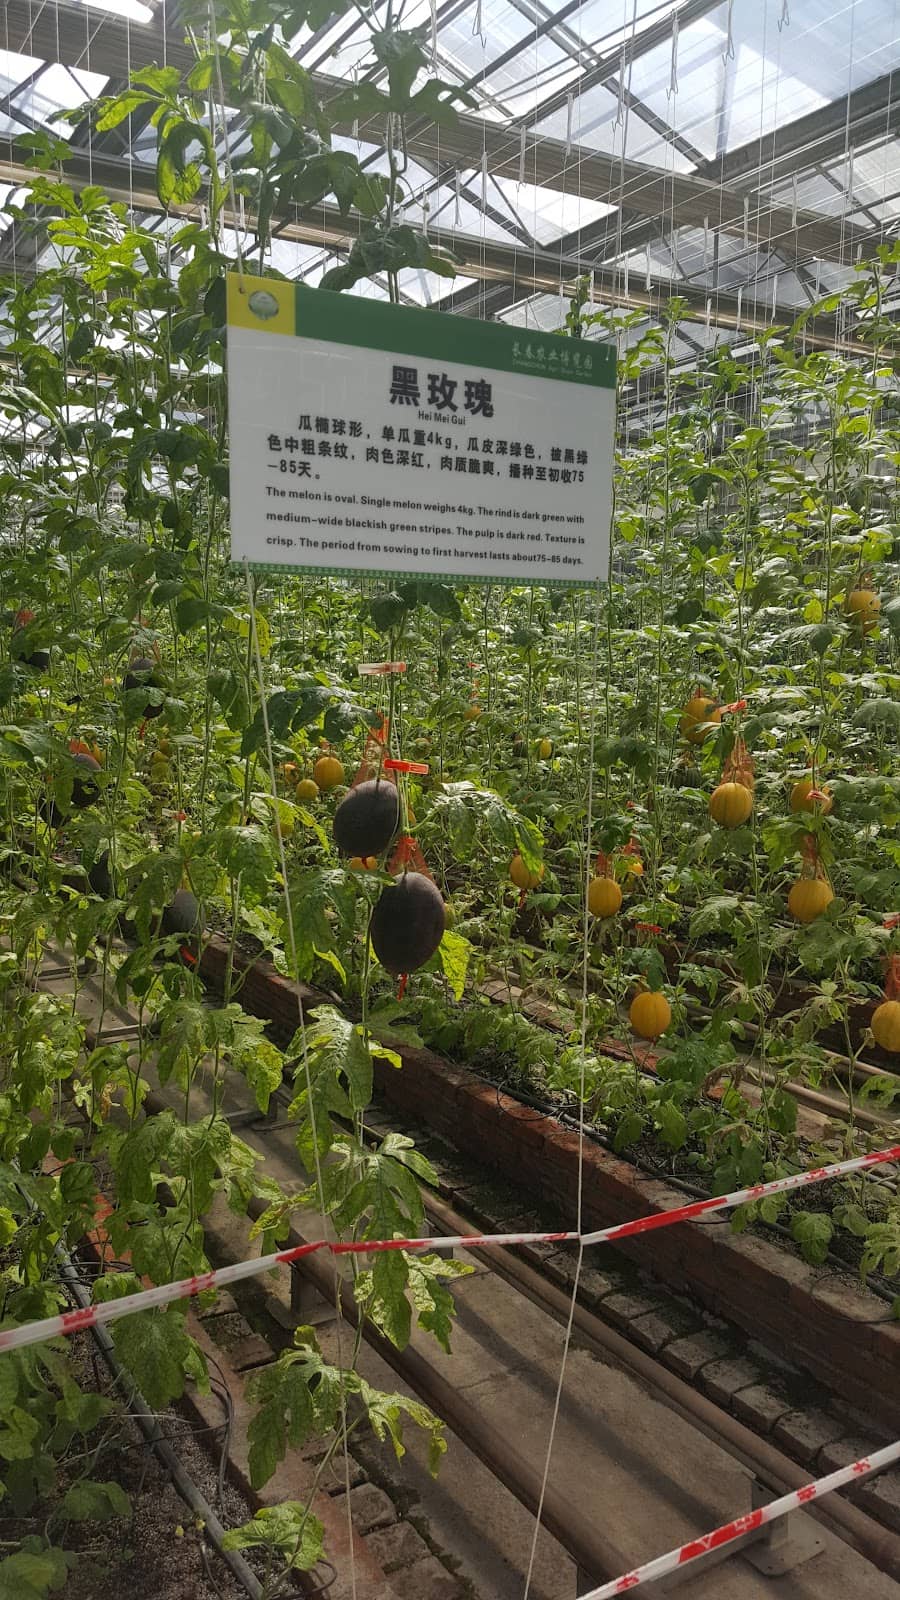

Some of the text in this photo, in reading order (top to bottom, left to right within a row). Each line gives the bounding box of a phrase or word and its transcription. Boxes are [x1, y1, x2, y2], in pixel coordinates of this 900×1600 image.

[390, 365, 494, 418] 黑玫瑰
[418, 411, 466, 425] Hei Mei Gui
[266, 487, 584, 523] The melon is oval. Single melon weighs 4kg. The rind is dark green with
[345, 518, 387, 530] blackish
[390, 523, 416, 532] green
[419, 524, 454, 535] stripes.
[456, 527, 473, 536] The
[475, 529, 494, 538] pulp
[497, 530, 504, 538] is
[506, 532, 525, 540] dark
[527, 533, 543, 541] red.
[545, 534, 576, 544] Texture
[578, 536, 585, 544] is
[266, 537, 296, 548] crisp.
[299, 538, 319, 548] The
[322, 540, 355, 550] period
[357, 542, 381, 552] from
[384, 545, 418, 556] sowing
[433, 548, 451, 557] first
[454, 549, 487, 559] harvest
[489, 551, 510, 560] lasts
[562, 556, 584, 566] days.
